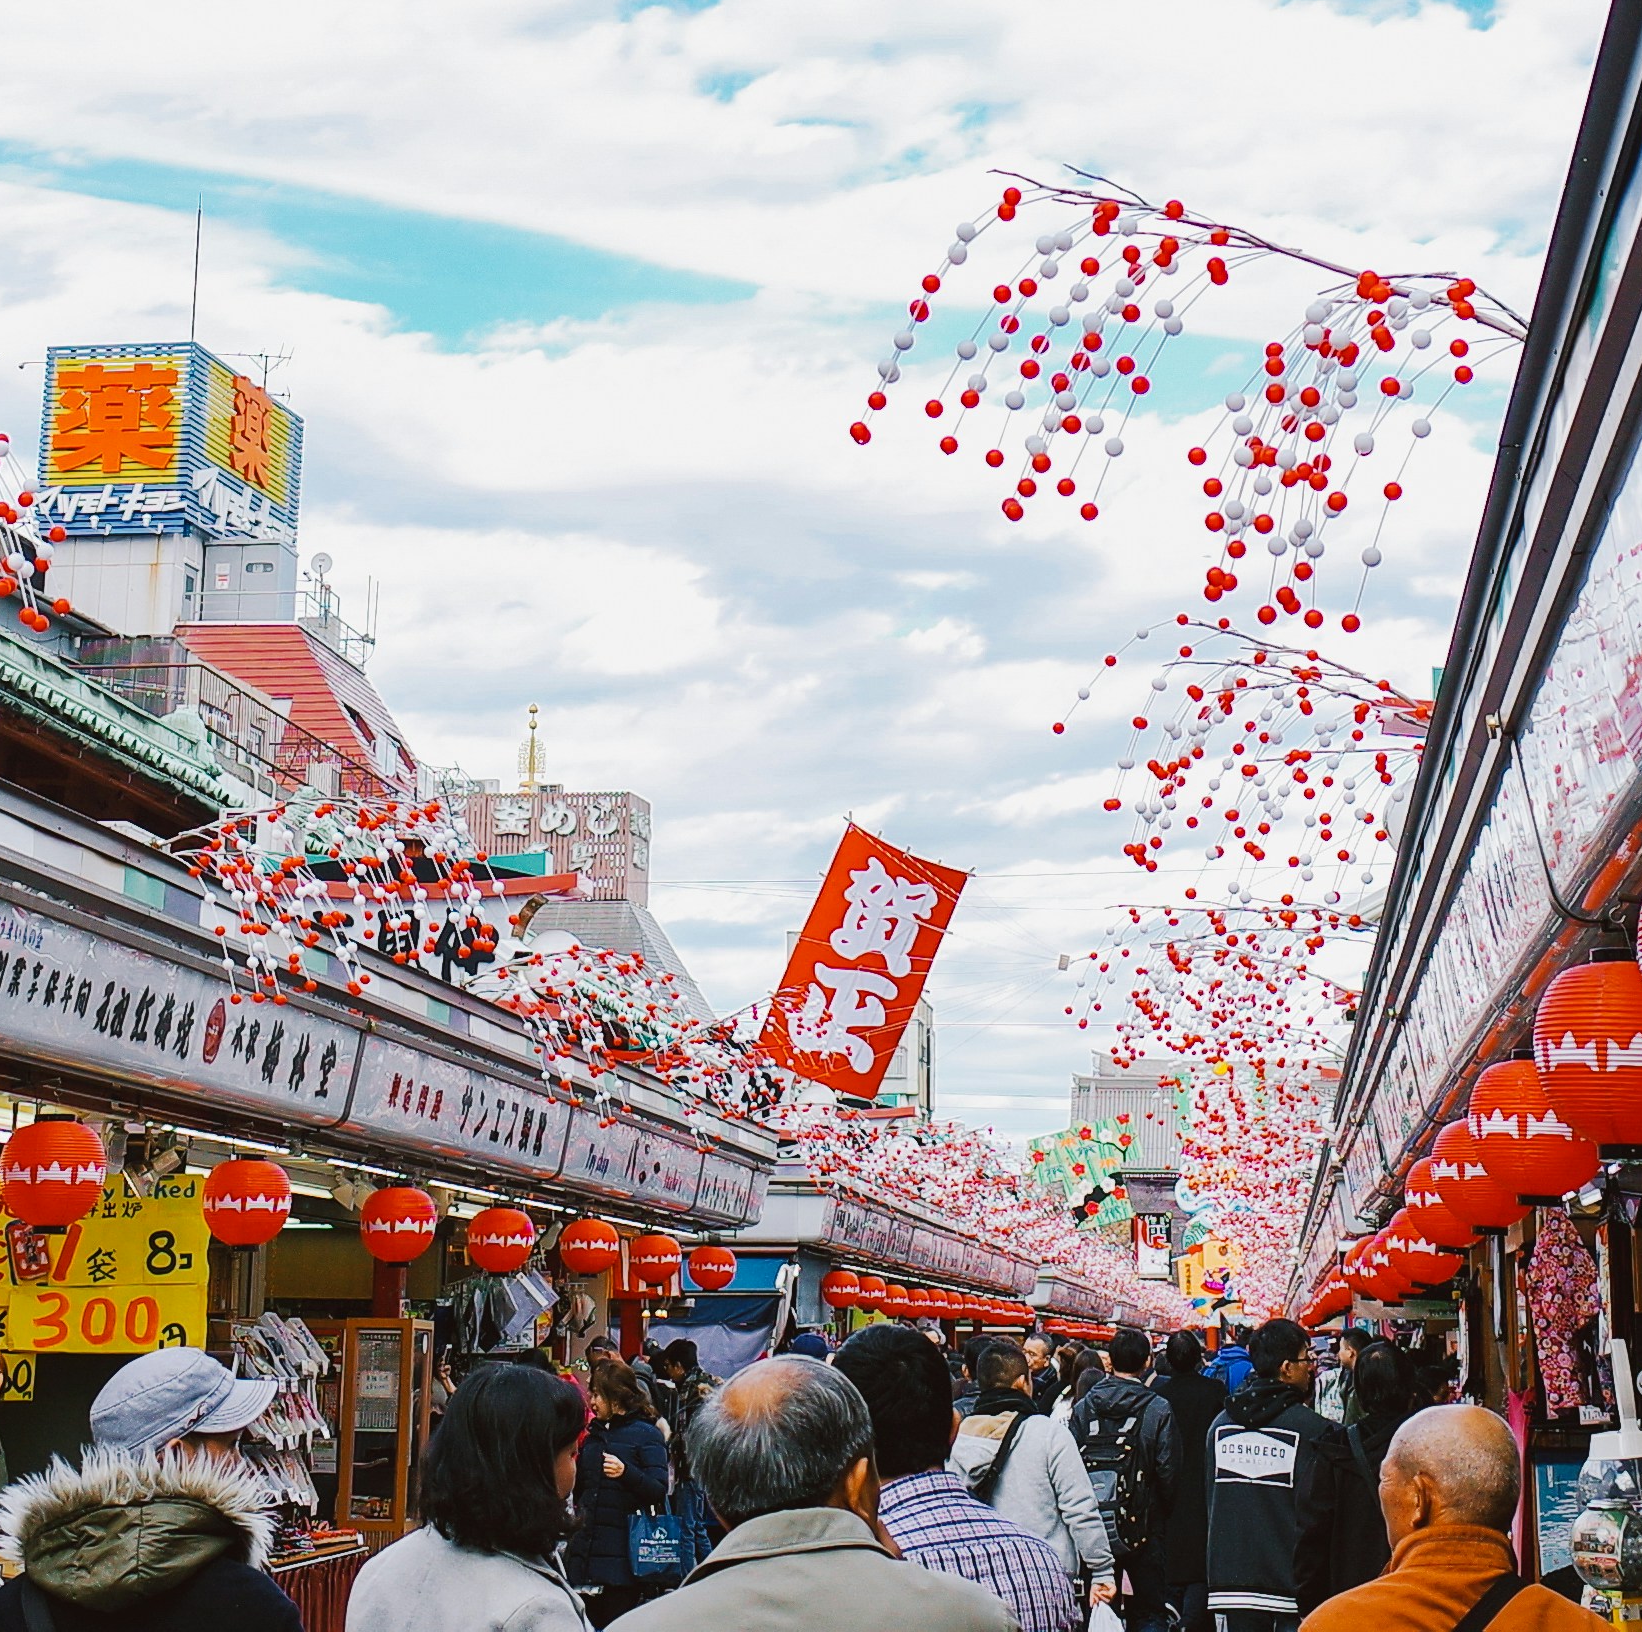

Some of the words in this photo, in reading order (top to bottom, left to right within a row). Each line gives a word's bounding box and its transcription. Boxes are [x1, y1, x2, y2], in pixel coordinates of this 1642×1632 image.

[53, 363, 179, 474] 薬
[229, 375, 273, 490] 薬
[35, 482, 186, 522] マツモトキヨシ
